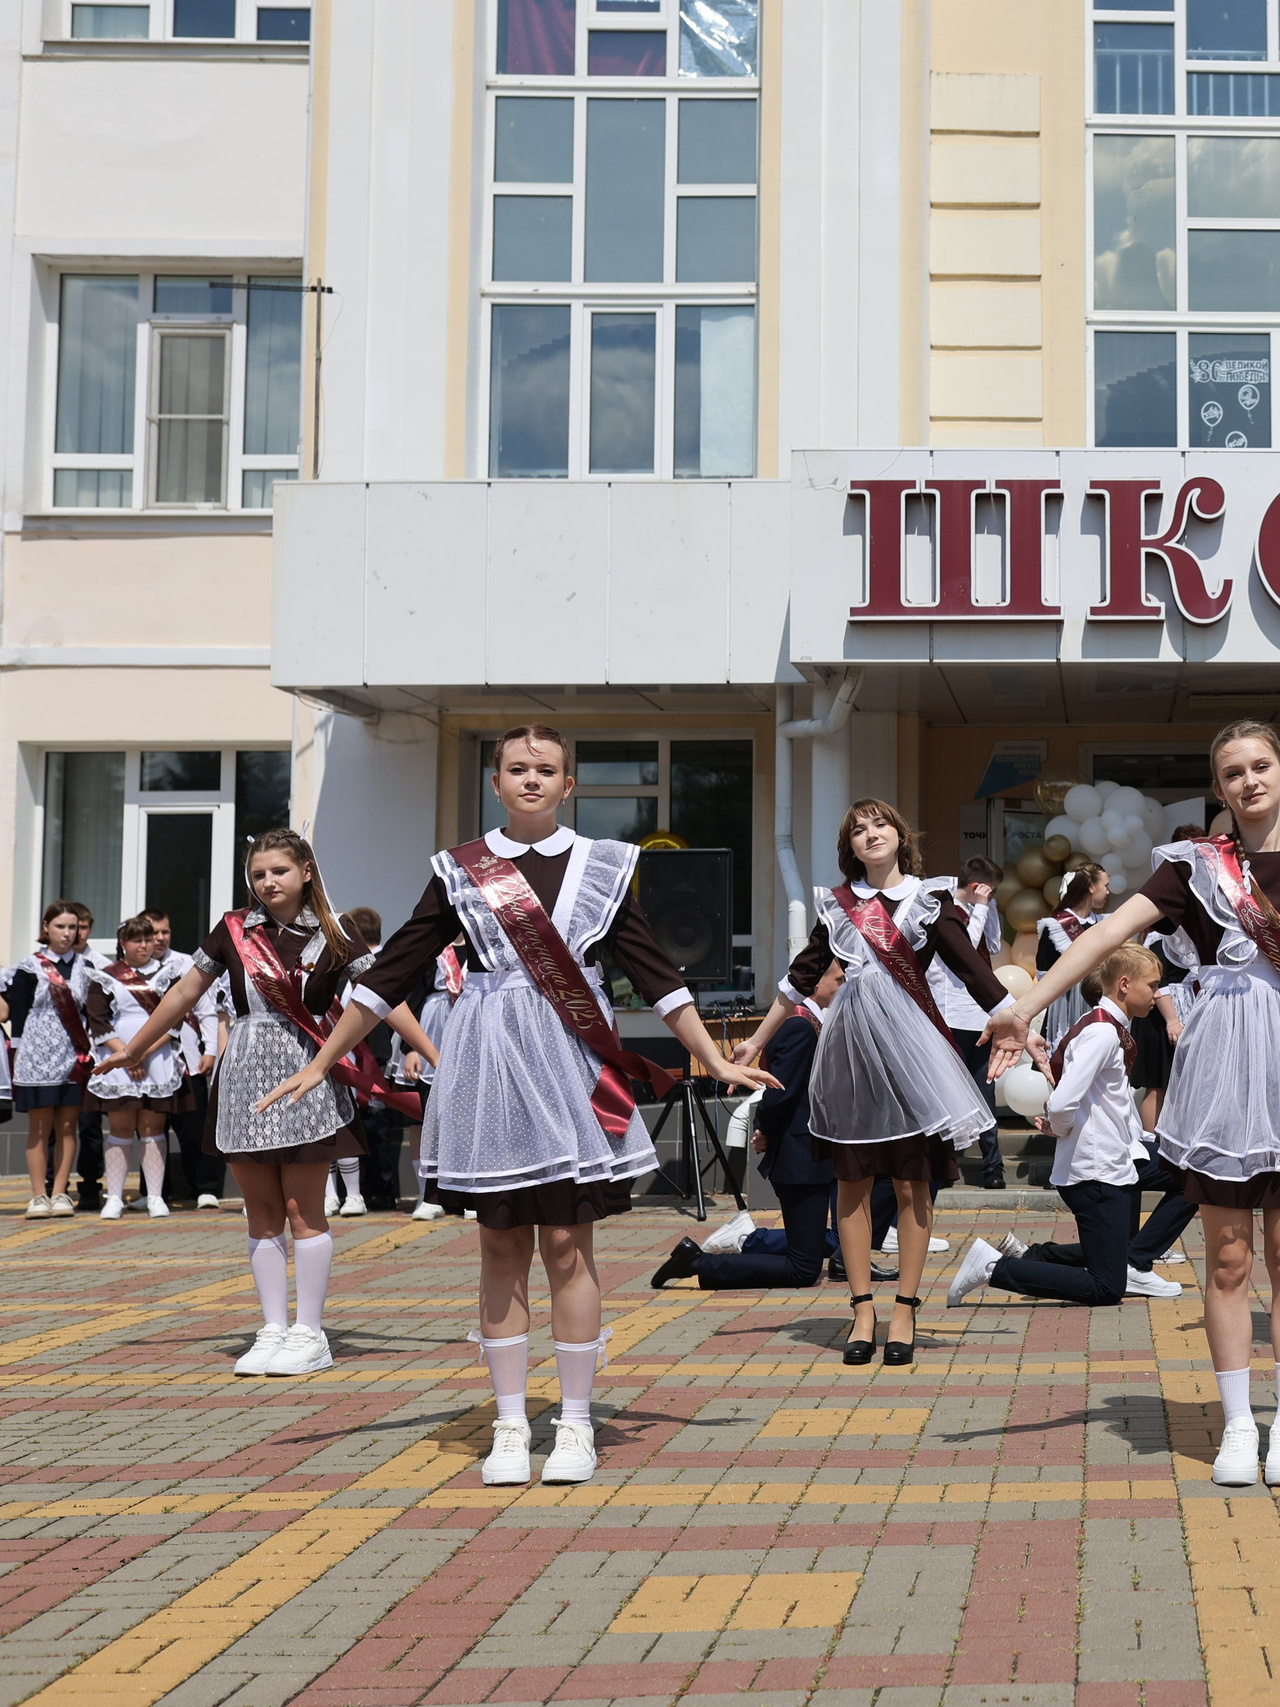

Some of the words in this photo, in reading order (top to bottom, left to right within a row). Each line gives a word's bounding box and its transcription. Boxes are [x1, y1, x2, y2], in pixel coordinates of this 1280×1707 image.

[1225, 360, 1268, 371] ВЕЛИКОЙ
[1011, 831, 1042, 840] РОСТА
[488, 873, 568, 988] Выпускница
[558, 988, 603, 1030] 2025
